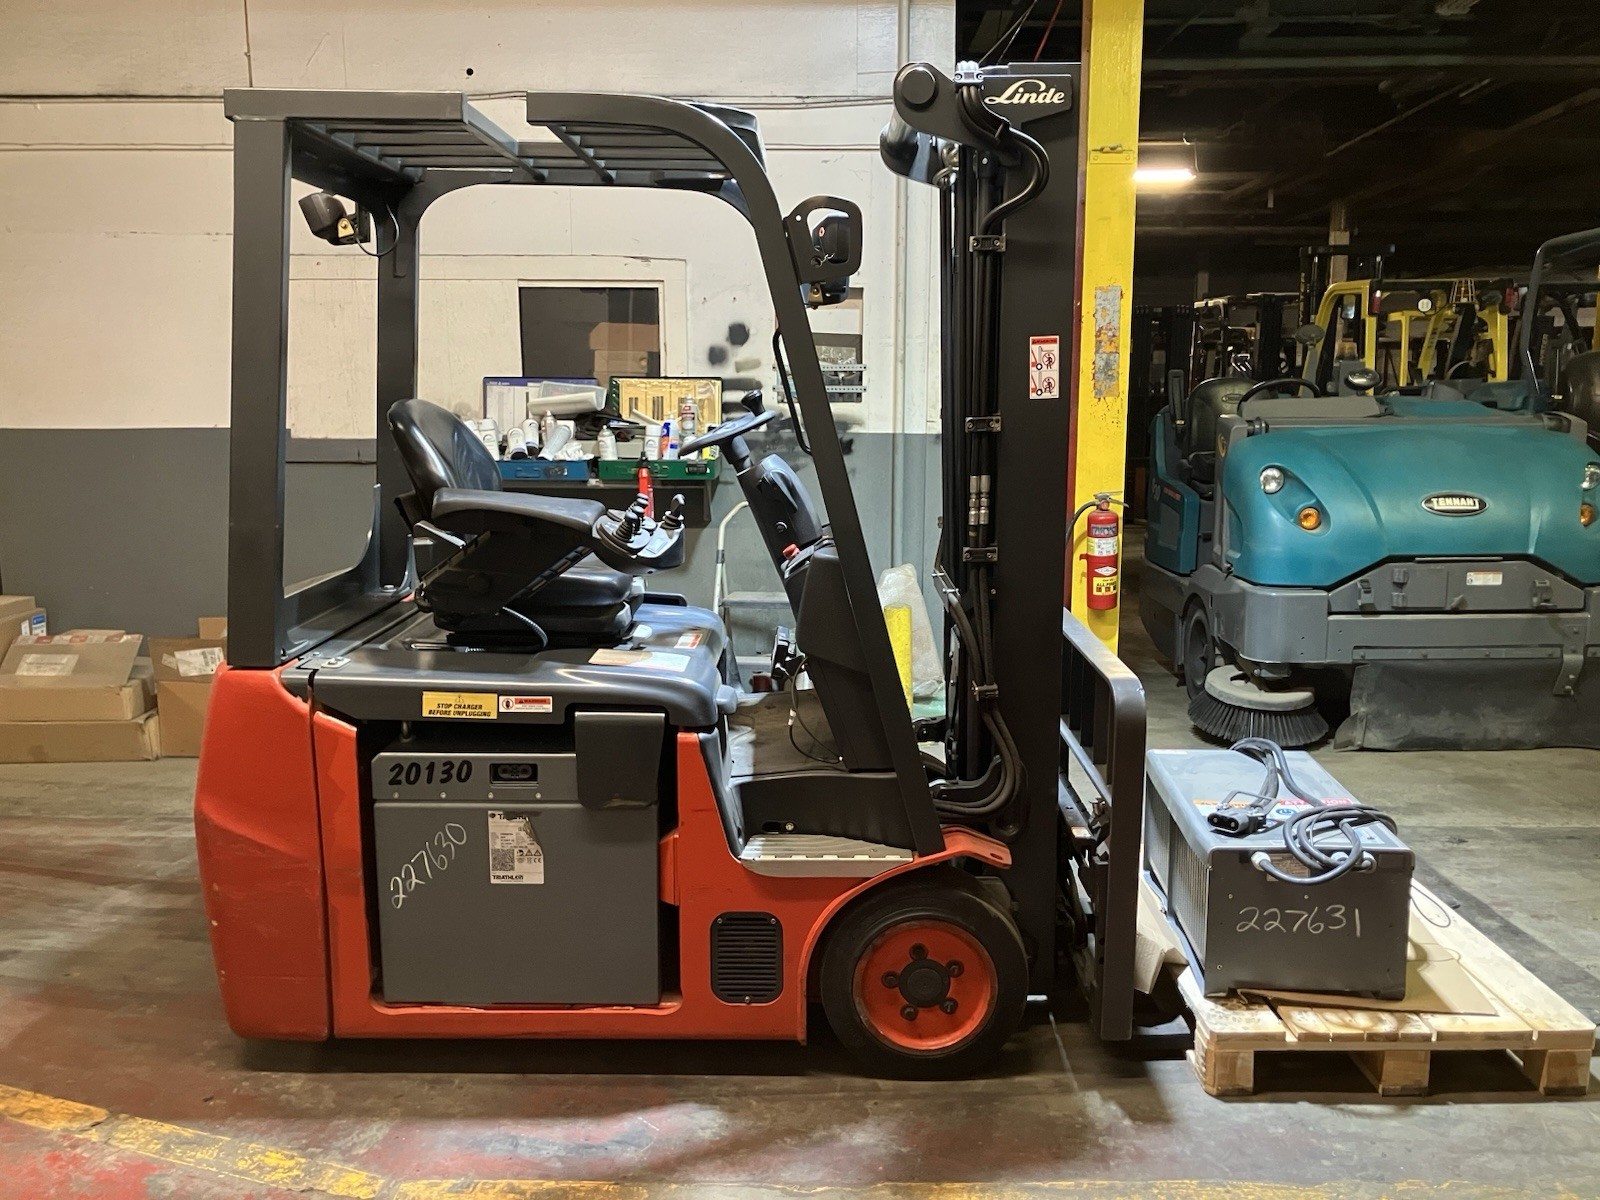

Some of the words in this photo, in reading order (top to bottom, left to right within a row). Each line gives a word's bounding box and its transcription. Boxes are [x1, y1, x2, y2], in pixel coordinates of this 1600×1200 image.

[984, 79, 1065, 104] Linde
[1431, 497, 1480, 510] TENNANT
[388, 760, 473, 786] 20130
[390, 823, 467, 909] 227630
[1236, 904, 1361, 938] 227631
